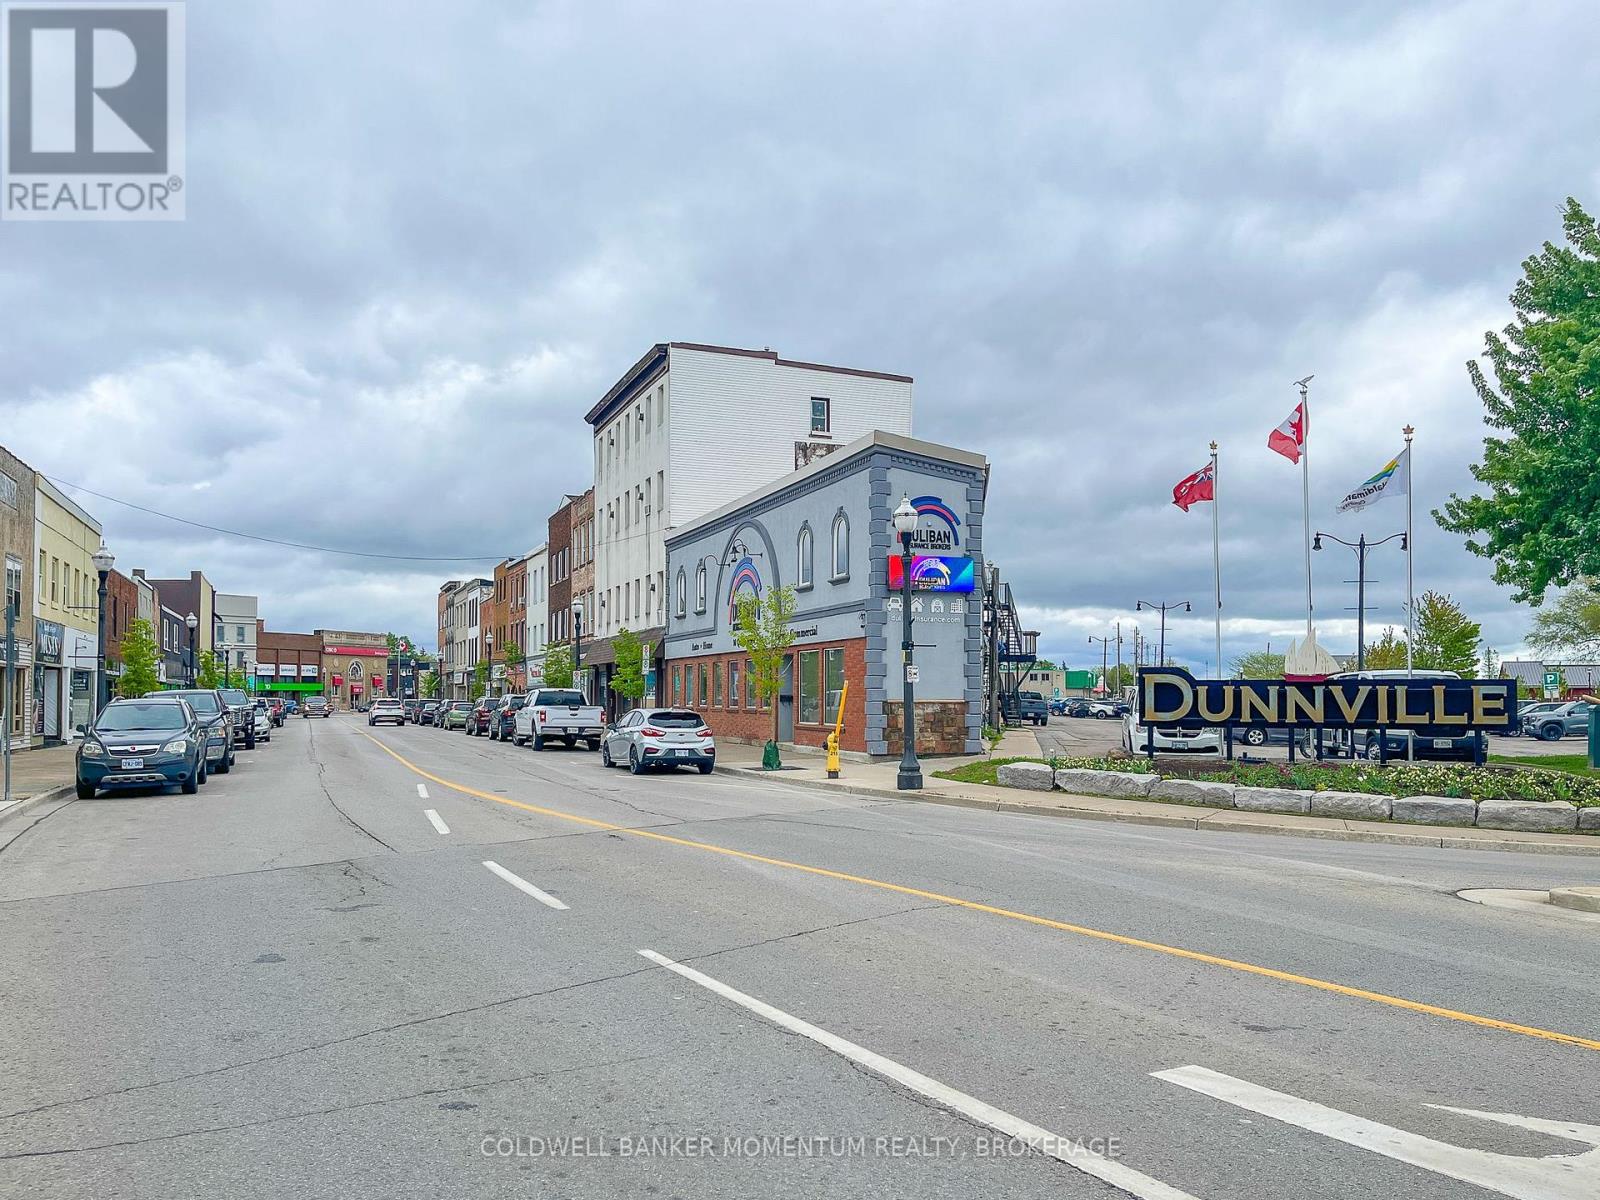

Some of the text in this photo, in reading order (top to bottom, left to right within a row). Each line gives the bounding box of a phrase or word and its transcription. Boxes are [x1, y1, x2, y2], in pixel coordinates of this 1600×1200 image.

[912, 529, 951, 543] ULIBAN
[1546, 674, 1555, 684] P
[1142, 673, 1508, 726] DUNNVILLE
